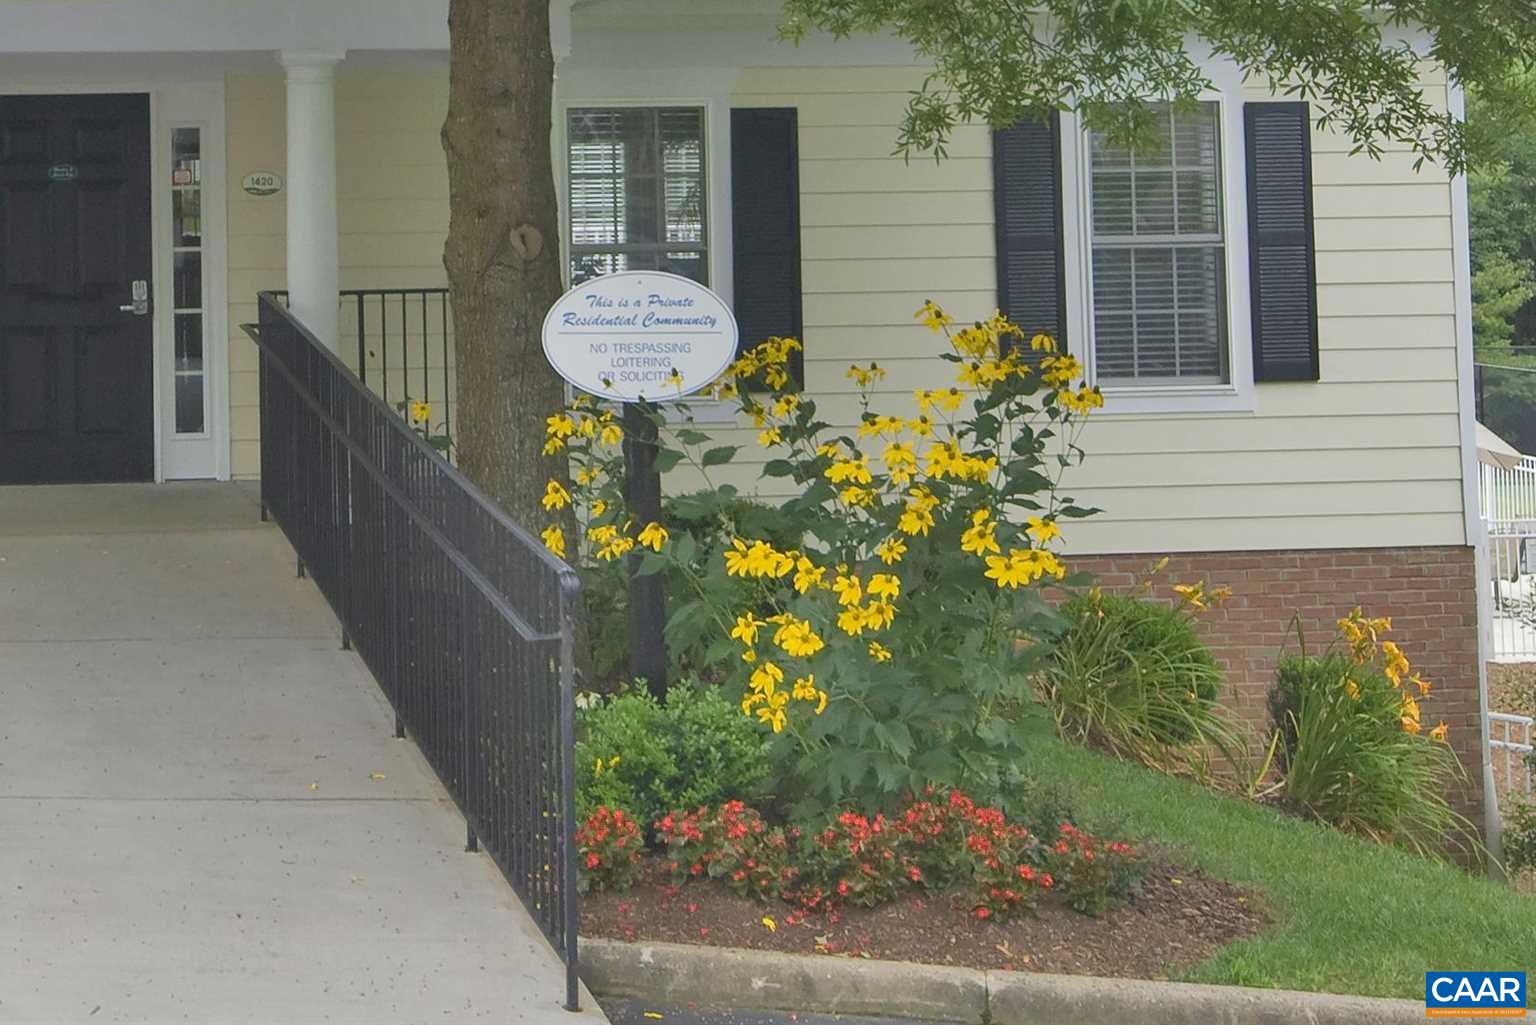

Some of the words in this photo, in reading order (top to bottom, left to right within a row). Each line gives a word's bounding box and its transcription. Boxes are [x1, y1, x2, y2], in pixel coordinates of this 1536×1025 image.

[586, 294, 613, 308] This
[618, 297, 629, 308] is
[633, 299, 641, 307] a
[648, 294, 694, 308] Private
[563, 312, 638, 327] Residential
[642, 311, 717, 328] Community
[590, 343, 608, 353] NO
[612, 343, 691, 353] TRESPASSING
[611, 357, 671, 367] LOITERING
[598, 371, 616, 381] OR
